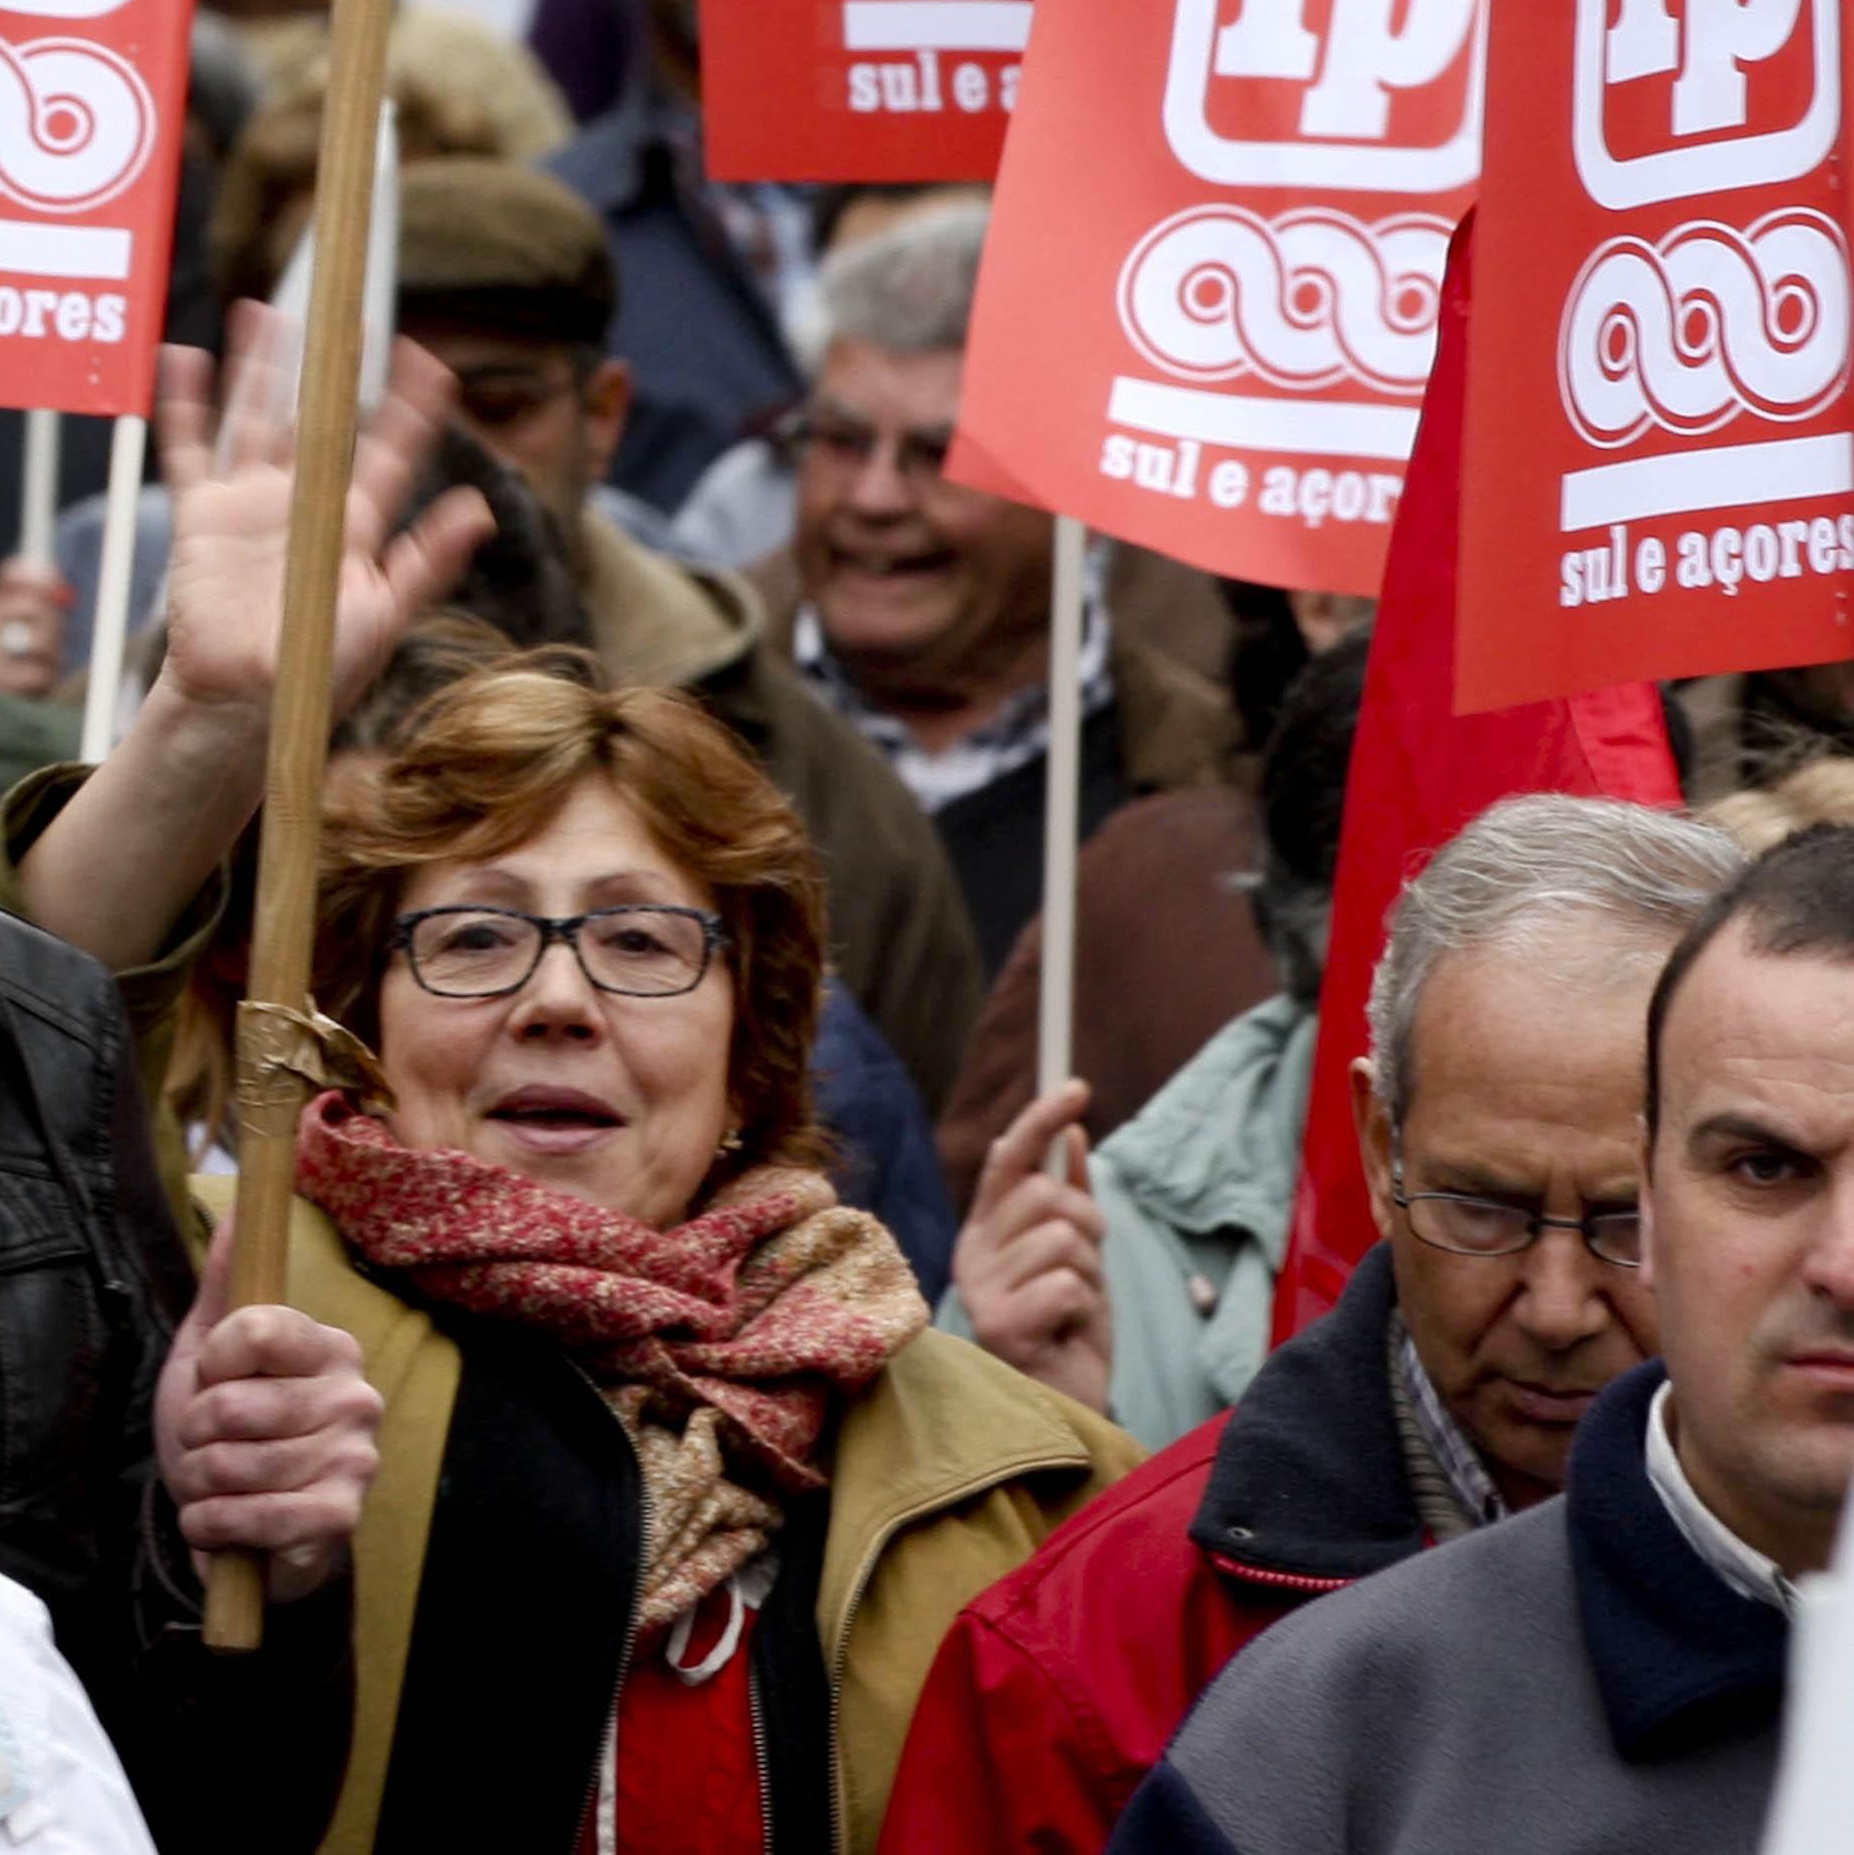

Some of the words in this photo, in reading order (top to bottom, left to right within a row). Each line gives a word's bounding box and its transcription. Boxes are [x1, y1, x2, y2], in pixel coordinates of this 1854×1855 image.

[848, 48, 945, 114] sul
[952, 61, 989, 114] e
[1098, 434, 1201, 500] sul
[1207, 459, 1251, 509] e
[1257, 465, 1406, 529] açor
[1559, 524, 1629, 607] sul
[1635, 536, 1667, 594] e
[1675, 512, 1854, 597] açores
